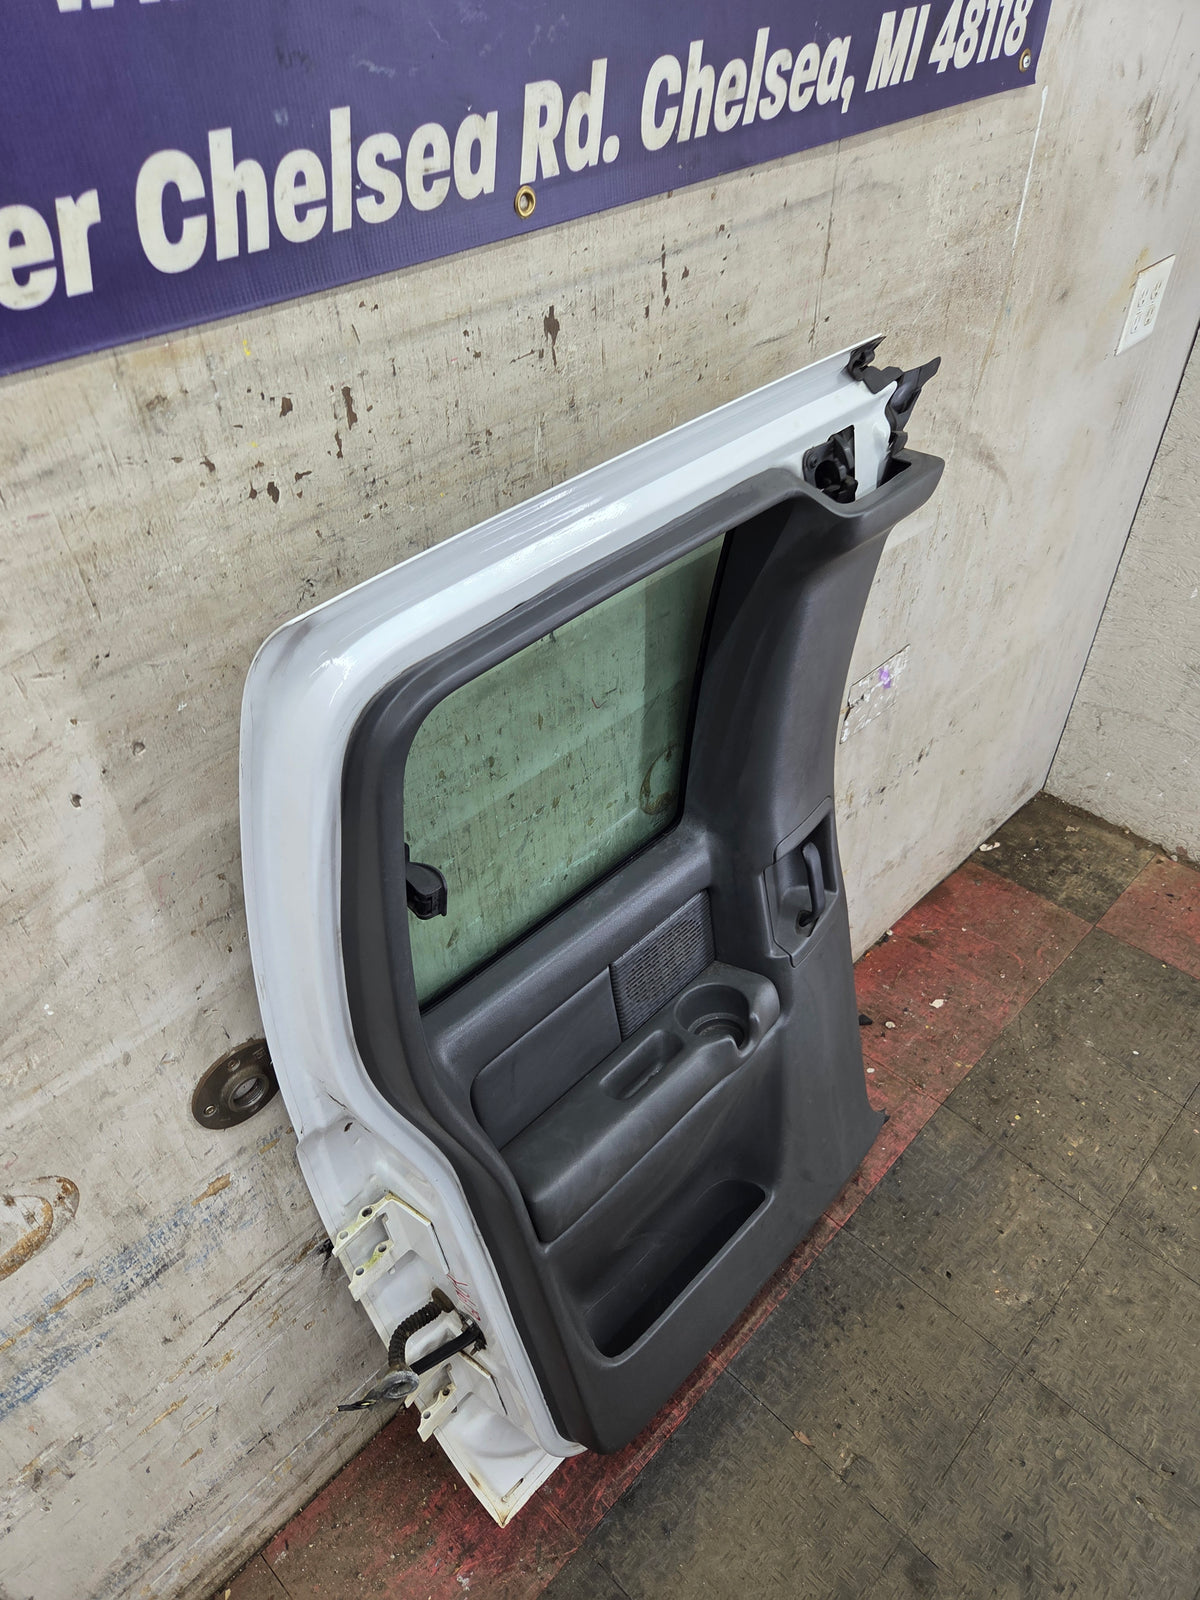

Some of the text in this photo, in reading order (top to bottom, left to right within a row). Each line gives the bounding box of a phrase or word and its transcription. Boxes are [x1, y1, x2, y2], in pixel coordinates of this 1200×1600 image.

[0, 0, 1034, 311] er Chelsea Rd. Chelsea, MI 48118
